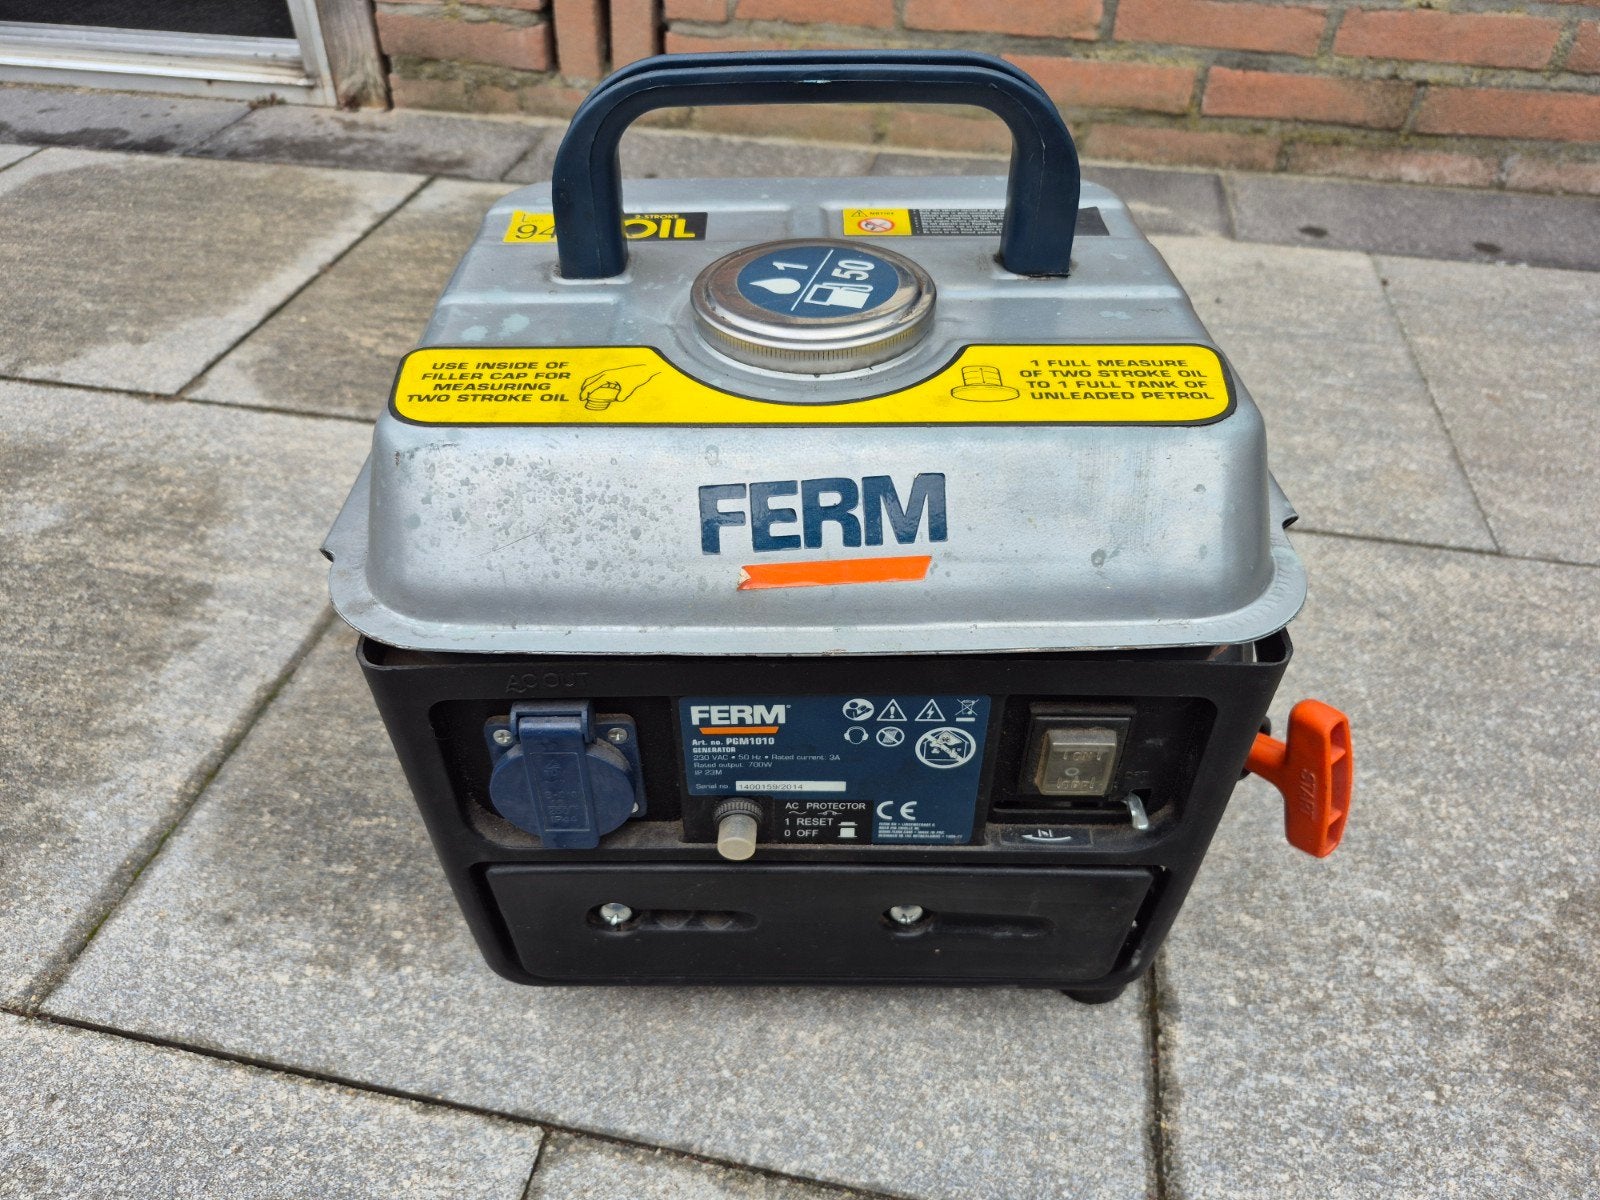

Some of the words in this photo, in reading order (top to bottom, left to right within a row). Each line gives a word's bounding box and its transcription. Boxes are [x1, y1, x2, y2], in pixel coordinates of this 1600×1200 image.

[623, 218, 696, 239] OIL
[831, 260, 875, 281] 50
[432, 362, 469, 370] USE
[475, 362, 538, 370] INSIDE
[545, 361, 570, 369] OF
[1097, 359, 1189, 367] MEASURE
[421, 372, 483, 380] FILLER
[490, 372, 528, 380] CAP
[534, 372, 571, 380] FOR
[1019, 370, 1043, 378] OF
[1049, 370, 1092, 378] TWO
[1098, 370, 1172, 378] STROKE
[1177, 370, 1208, 378] OIL
[433, 383, 551, 391] MEASURING
[407, 394, 450, 402] TWO
[456, 394, 533, 402] STROKE
[540, 394, 570, 402] OIL
[1030, 392, 1135, 400] UNLEADED
[1142, 392, 1215, 400] PETROL
[698, 472, 949, 555] FERM
[725, 737, 775, 745] PGM1010
[785, 802, 799, 810] AC
[806, 802, 866, 810] PROTECTOR
[876, 800, 918, 820] CE
